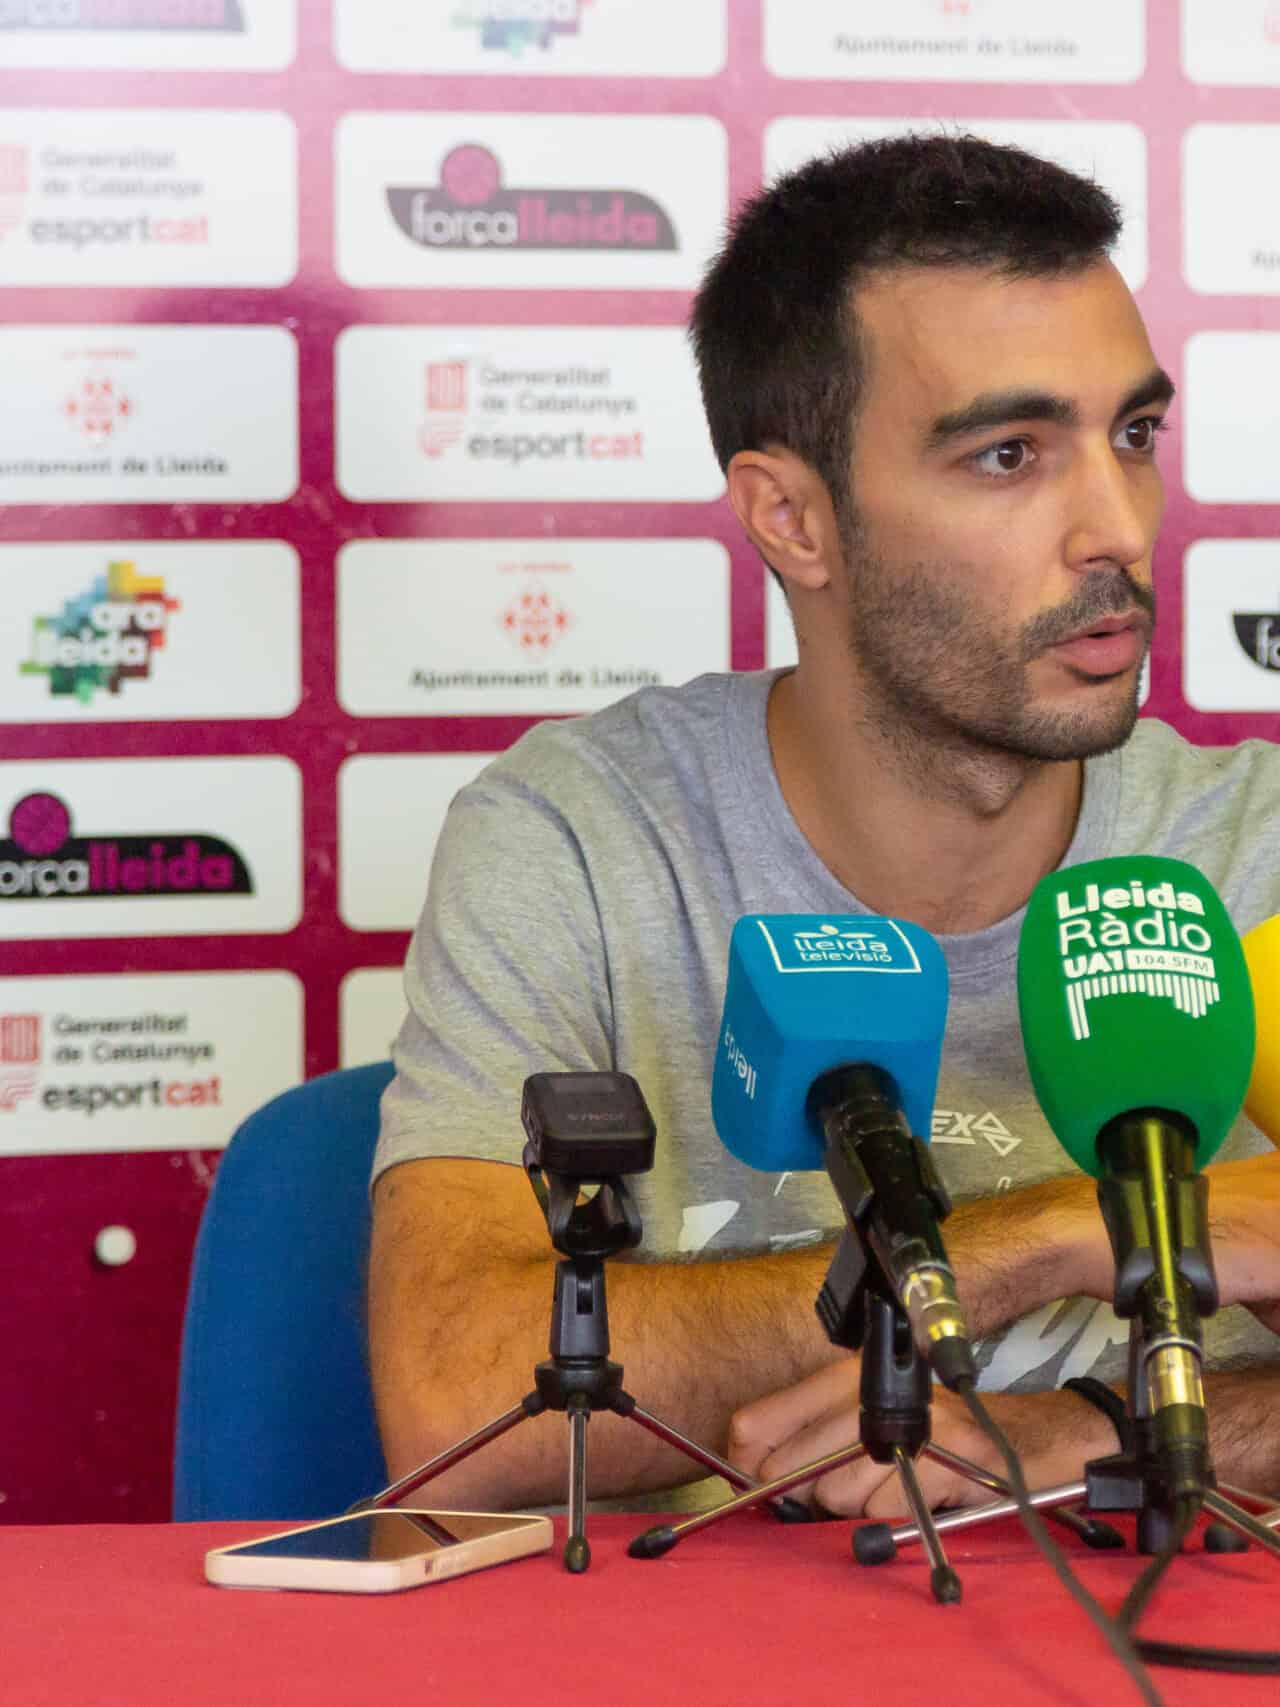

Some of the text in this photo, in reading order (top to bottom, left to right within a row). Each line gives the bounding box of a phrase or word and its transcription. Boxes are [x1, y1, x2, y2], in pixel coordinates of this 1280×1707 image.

[30, 212, 209, 248] esportcat
[467, 431, 643, 467] esportcat
[1056, 880, 1206, 920] Lleida
[793, 937, 889, 953] lleida
[1059, 911, 1212, 956] Ràdio
[800, 950, 893, 963] televisió
[1063, 950, 1125, 979] UA1
[54, 1013, 188, 1035] Generalitat
[54, 1040, 215, 1066] de Catalunya
[42, 1074, 221, 1116] esportcat
